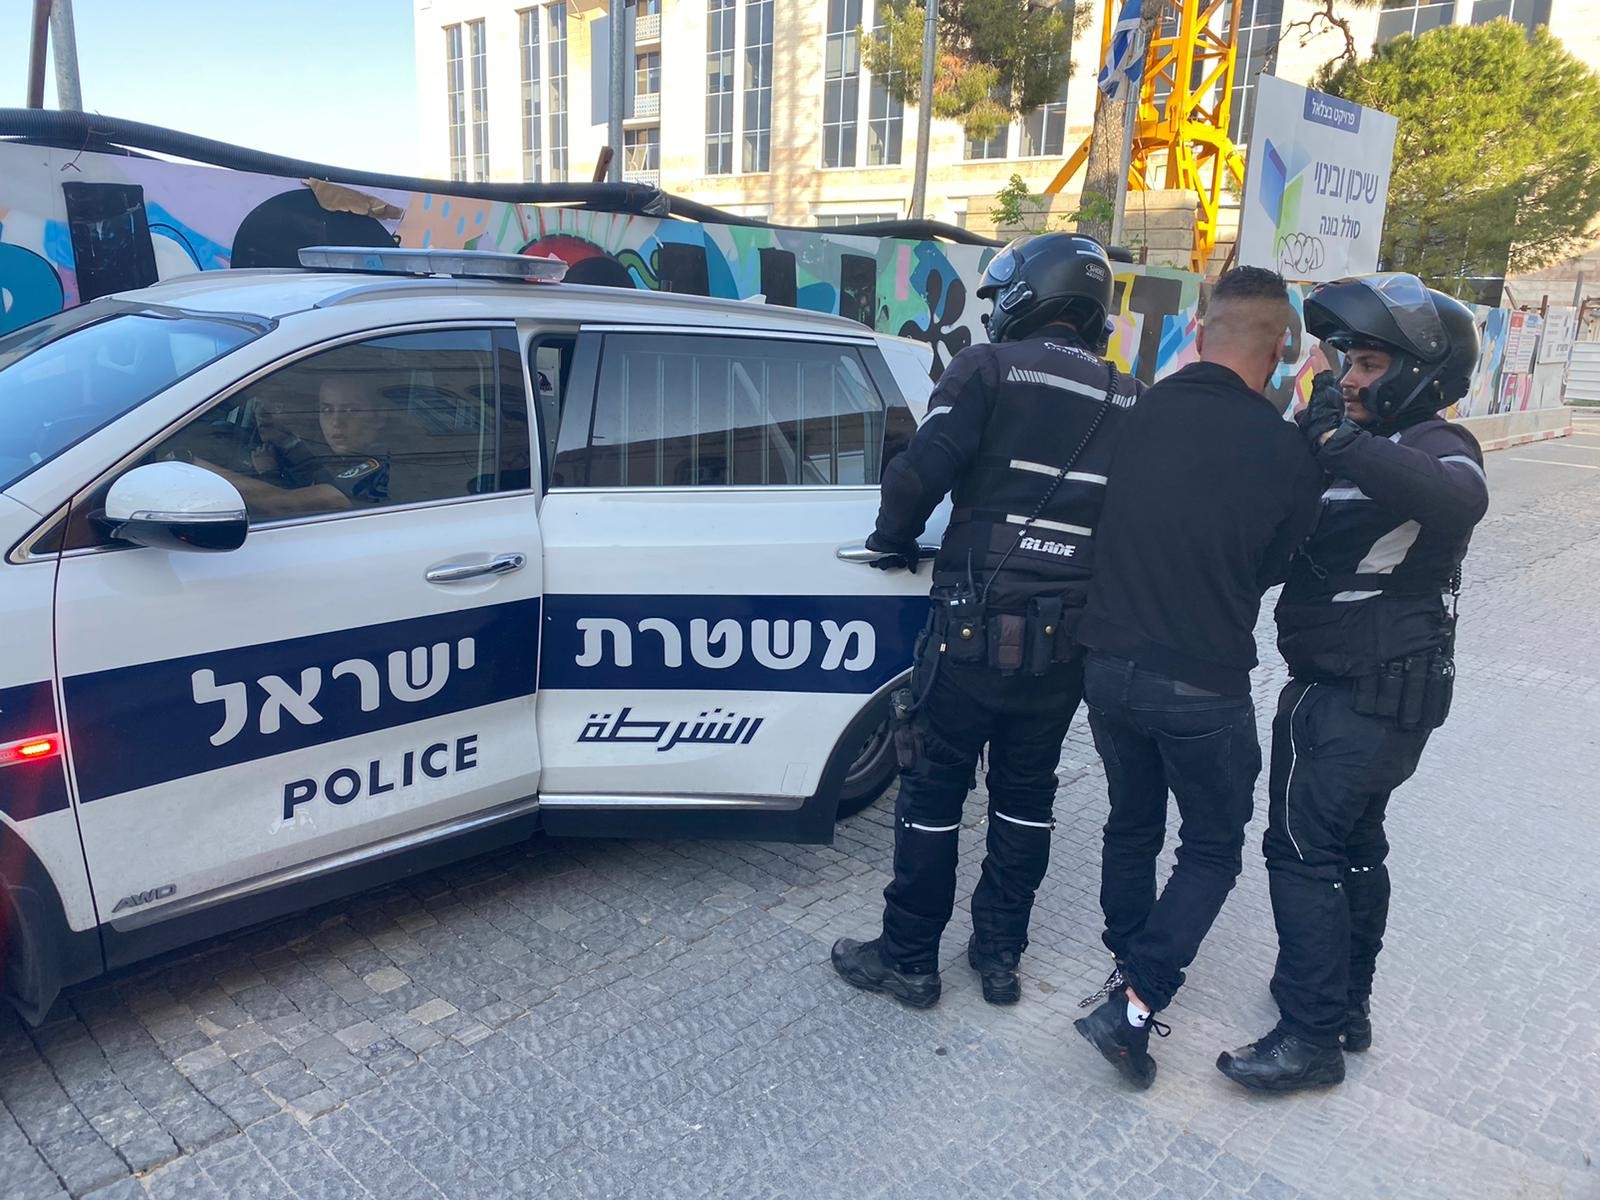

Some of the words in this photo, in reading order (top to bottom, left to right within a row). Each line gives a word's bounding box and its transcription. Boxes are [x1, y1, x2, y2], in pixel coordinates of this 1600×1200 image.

[1311, 98, 1333, 119] בצלאל
[1333, 109, 1356, 125] פרויקט
[1314, 161, 1346, 199] ובינוי
[1345, 169, 1379, 204] שיכון
[1319, 215, 1339, 236] בונה
[1340, 214, 1361, 239] סולל
[1019, 536, 1076, 557] BLADE
[575, 617, 876, 671] משטרת
[191, 637, 475, 746] ישראל
[576, 707, 764, 752] الشرطة
[283, 734, 478, 820] POLICE
[111, 883, 177, 913] AWD
